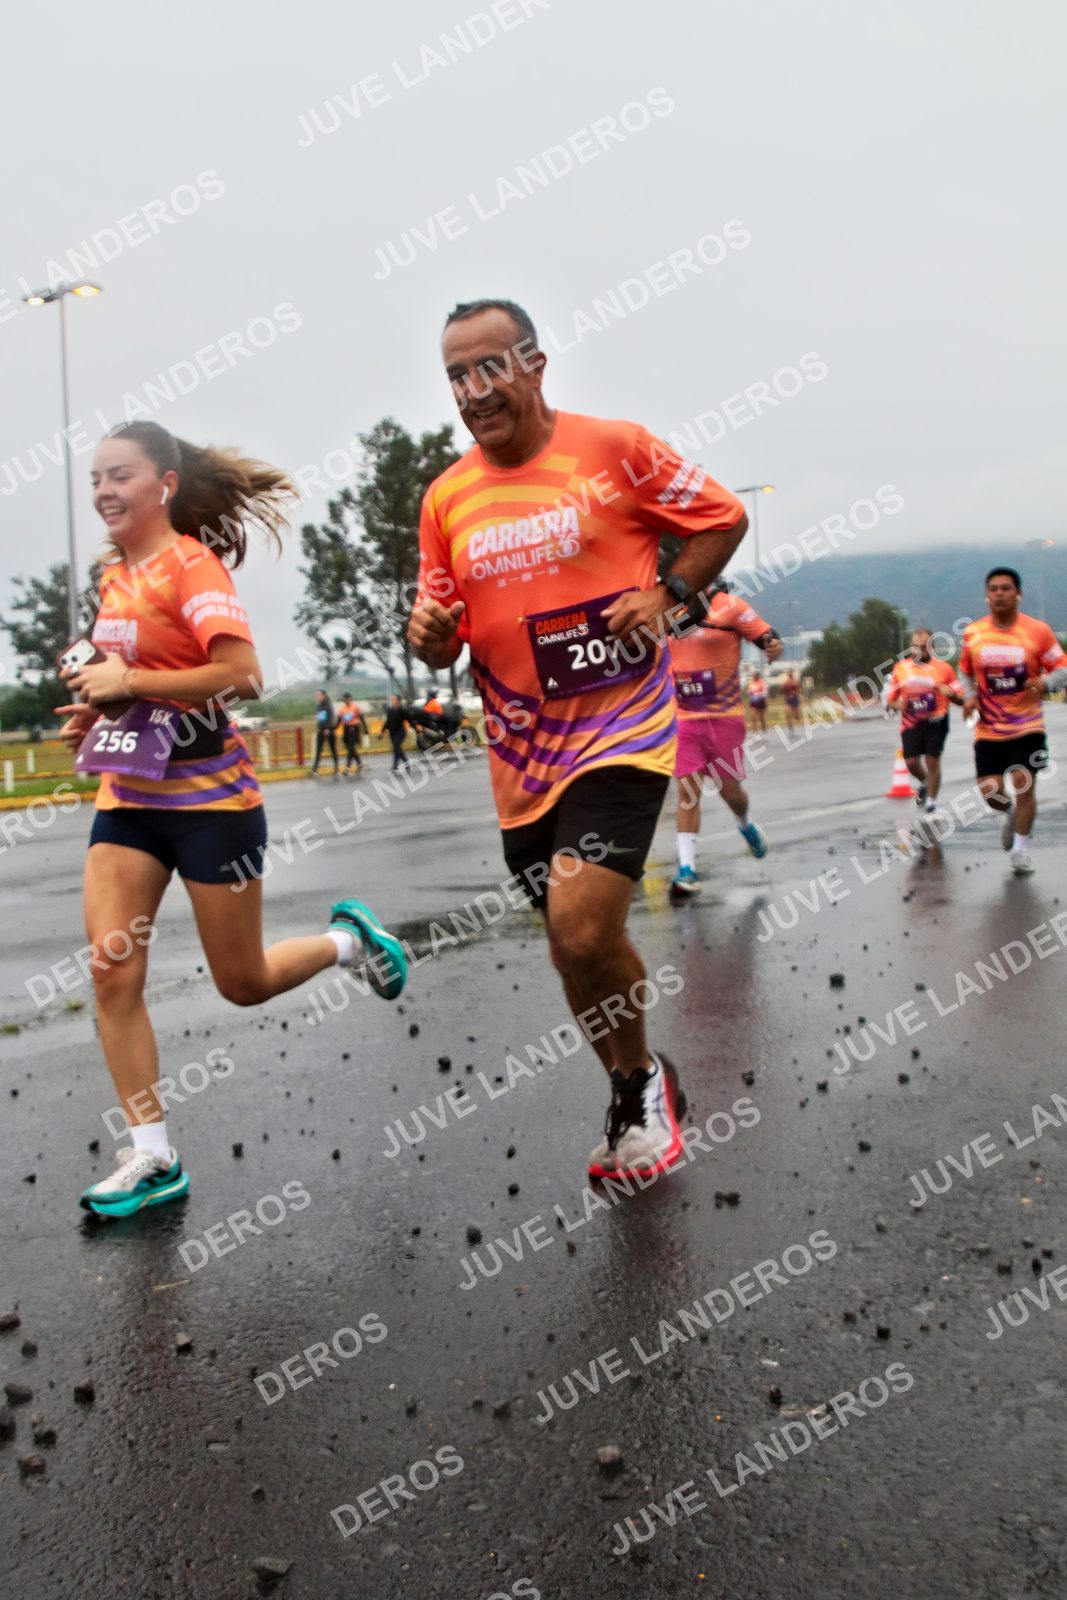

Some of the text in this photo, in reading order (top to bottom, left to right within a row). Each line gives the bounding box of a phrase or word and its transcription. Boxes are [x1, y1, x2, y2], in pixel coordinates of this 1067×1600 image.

[468, 506, 580, 561] CARRERA
[471, 543, 556, 580] OMNILIFE
[535, 611, 588, 635] CARRERA
[148, 708, 174, 727] 15K
[93, 730, 139, 754] 256
